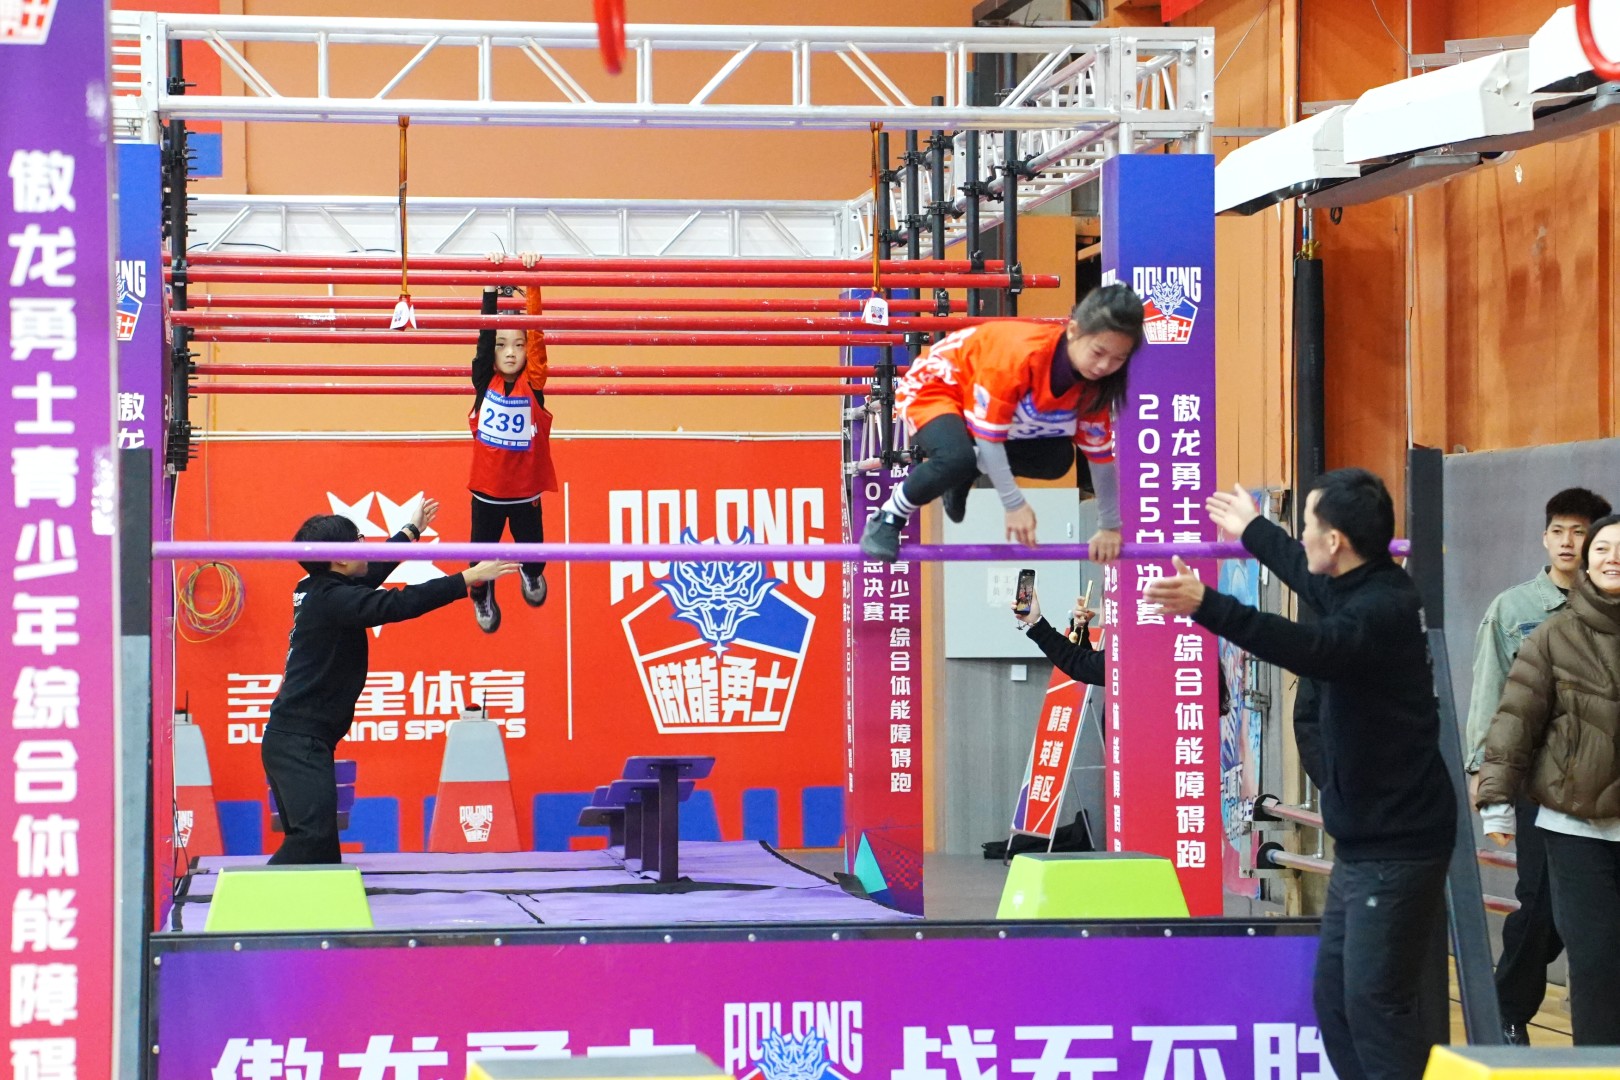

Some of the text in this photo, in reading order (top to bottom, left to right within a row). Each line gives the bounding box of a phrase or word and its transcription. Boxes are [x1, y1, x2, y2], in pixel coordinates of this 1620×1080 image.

[483, 407, 525, 433] 239
[608, 487, 826, 607] AOLONG
[227, 668, 526, 719] 多星体育
[648, 655, 791, 724] 傲龍勇士
[724, 1000, 863, 1074] AOLONG
